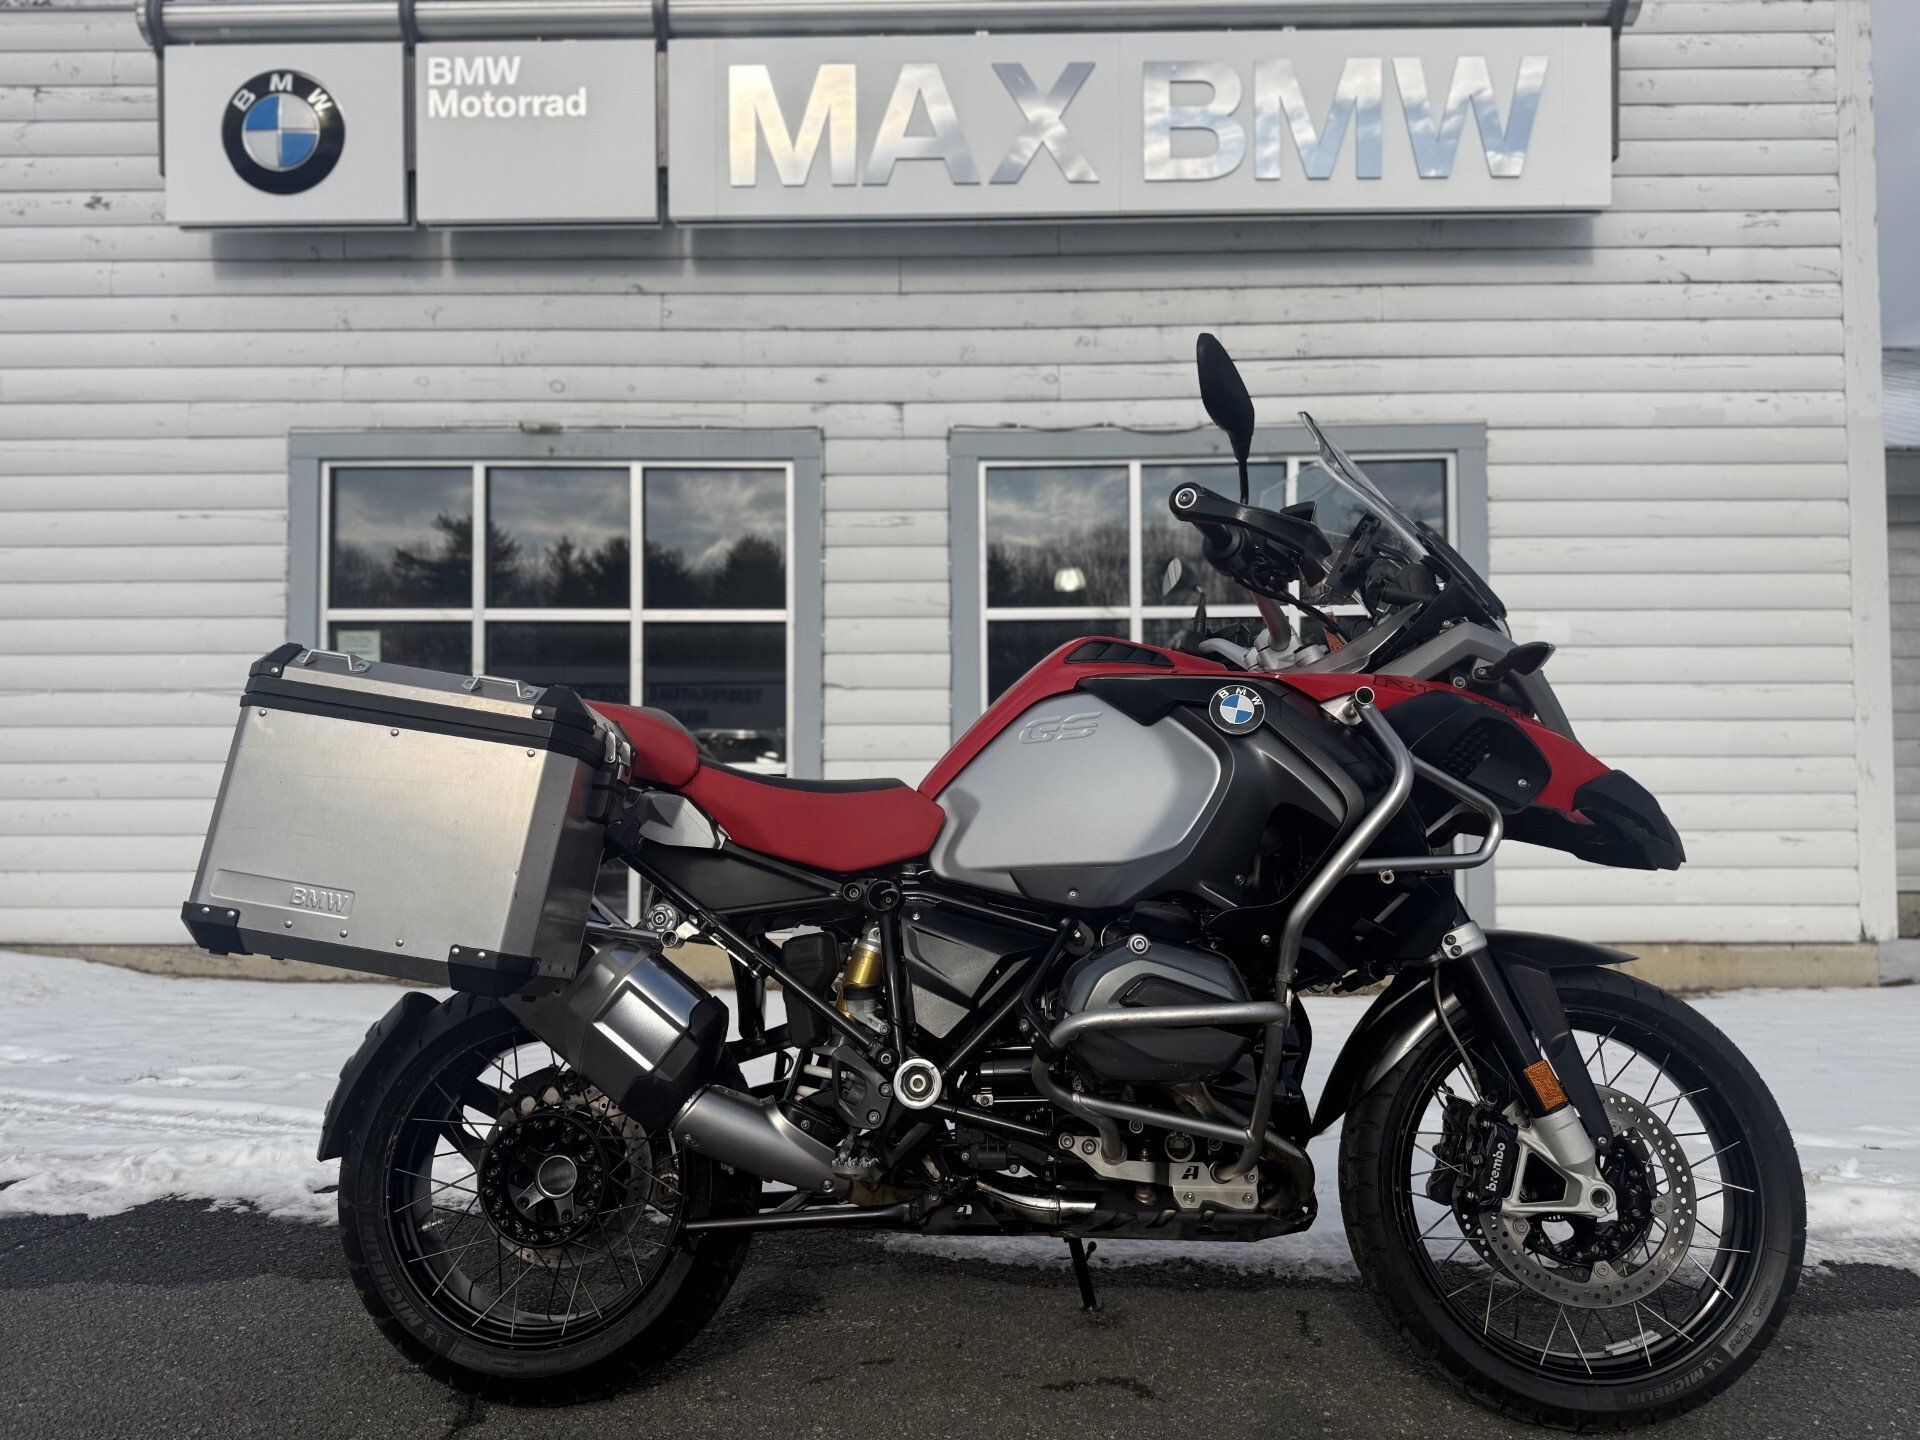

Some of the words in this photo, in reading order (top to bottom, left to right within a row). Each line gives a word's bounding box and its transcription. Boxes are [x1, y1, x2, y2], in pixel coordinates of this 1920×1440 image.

[427, 55, 521, 86] BMW
[233, 72, 333, 115] BMW
[427, 87, 587, 118] Motorrad
[728, 61, 1099, 188] MAX
[1143, 55, 1549, 183] BMW
[1217, 687, 1262, 706] BMW
[1019, 711, 1103, 744] GS
[289, 886, 349, 913] BMW
[1485, 1142, 1506, 1192] brembo
[362, 1225, 424, 1328] MICHELIN
[1627, 1368, 1706, 1404] MICHELIN
